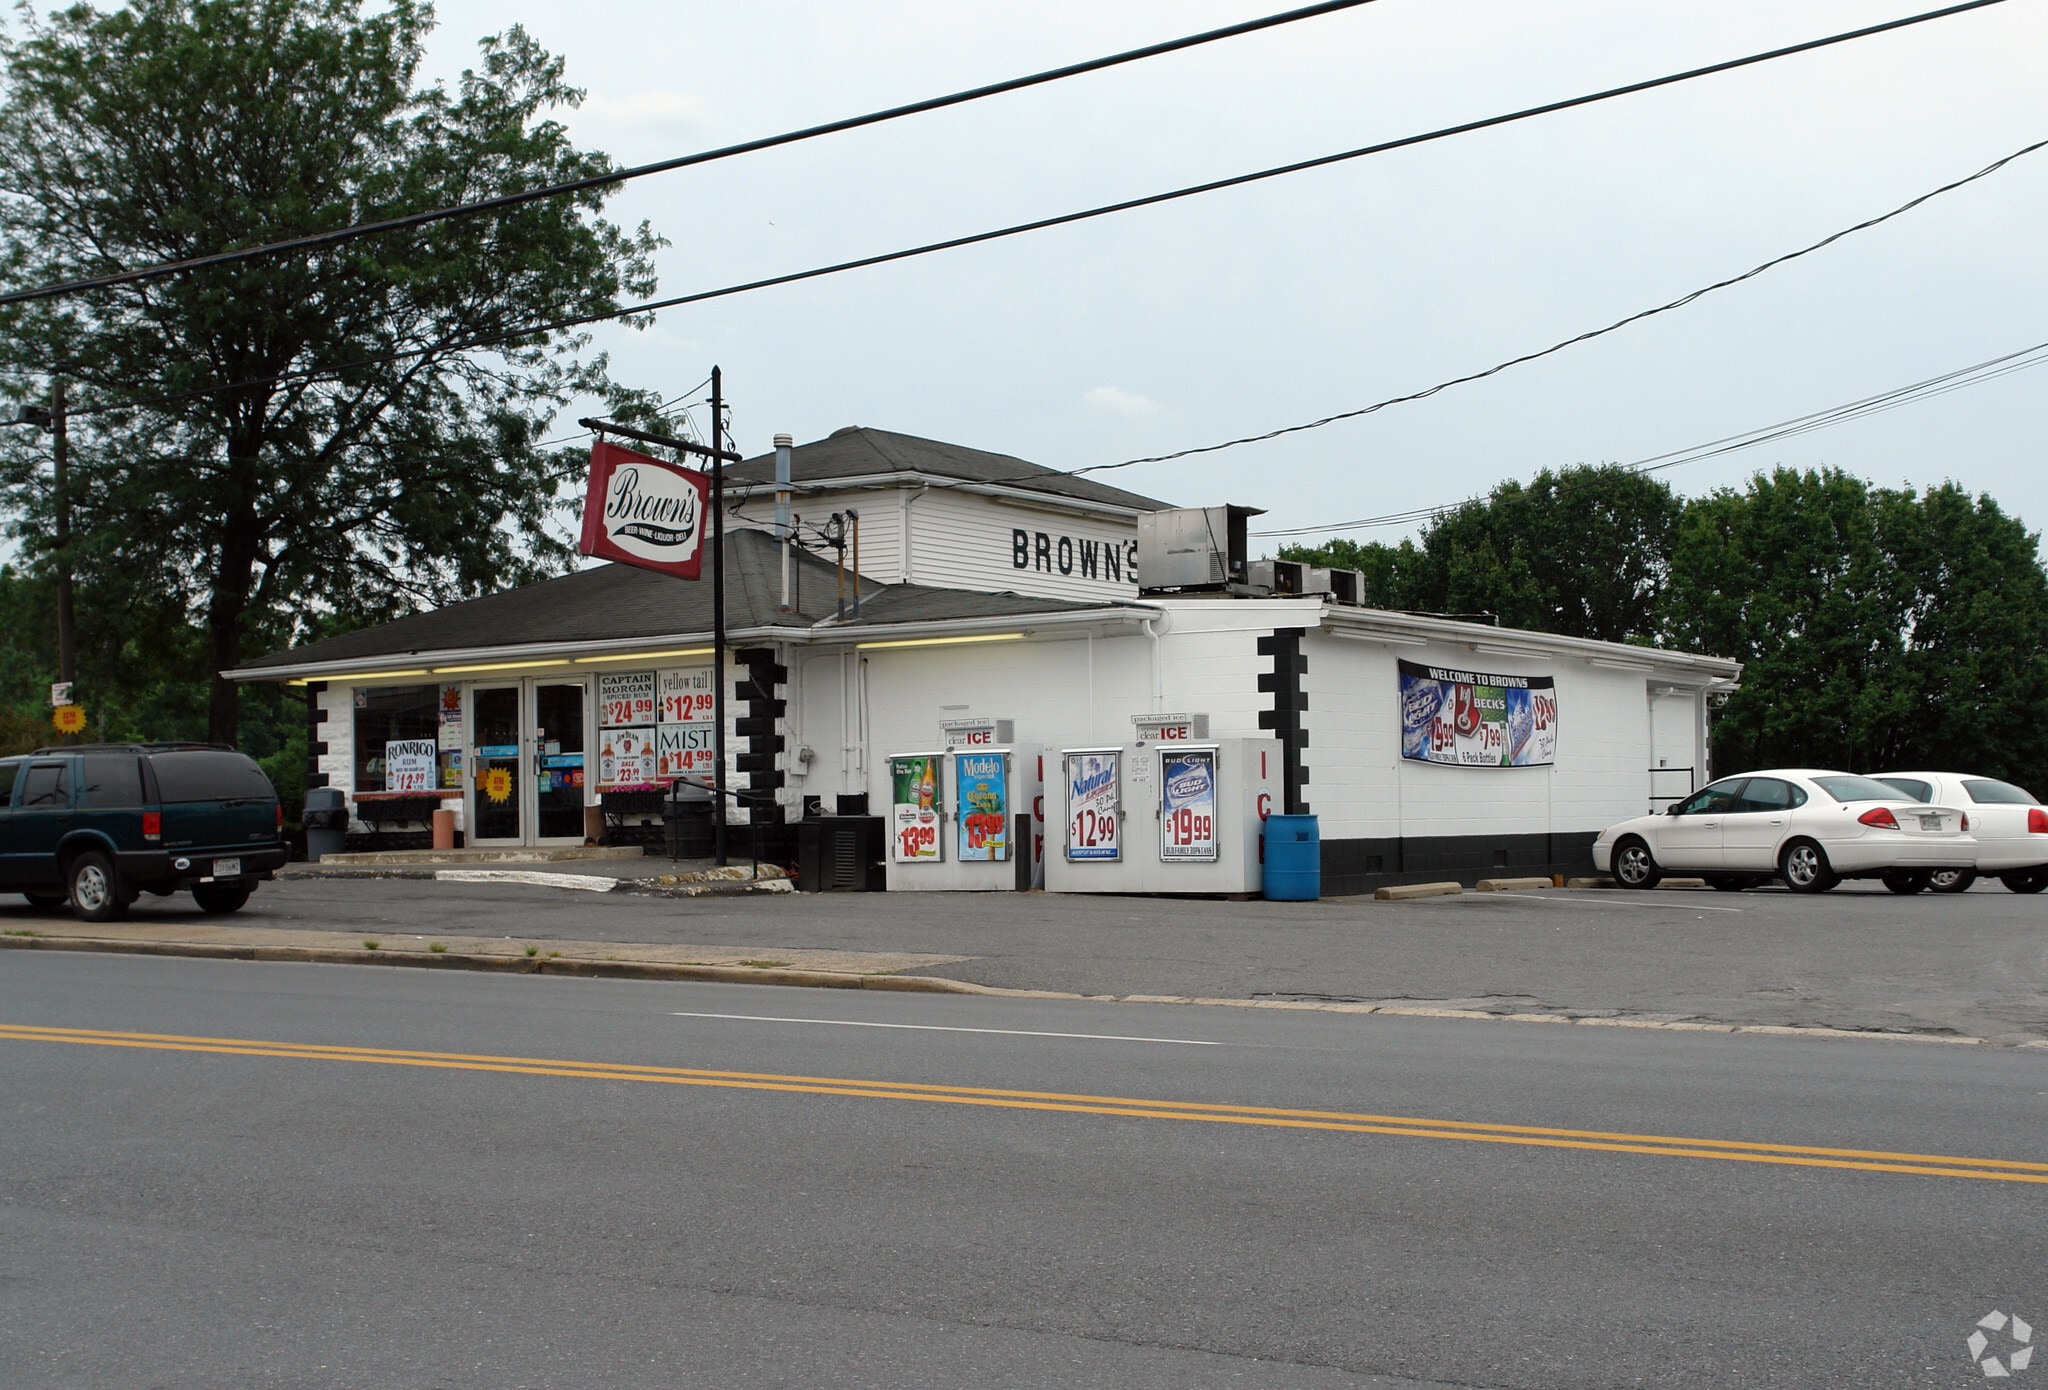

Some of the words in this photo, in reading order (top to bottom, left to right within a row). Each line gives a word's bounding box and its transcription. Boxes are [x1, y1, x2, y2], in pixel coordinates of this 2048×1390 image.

[607, 467, 695, 523] Brown's
[1012, 528, 1139, 584] BROWN'S
[602, 675, 652, 685] CAPTAIN
[1429, 668, 1476, 684] WELCOME
[1476, 674, 1489, 685] TO
[1490, 677, 1528, 688] BROWNS
[602, 684, 652, 694] MORGAN
[608, 699, 653, 723] $24.99
[666, 694, 713, 721] $12.99
[942, 720, 975, 728] packaged
[1134, 715, 1171, 723] packaged
[660, 729, 712, 750] MIST
[966, 731, 991, 745] ICE
[1140, 731, 1159, 740] clear
[1160, 726, 1188, 741] ICE
[388, 742, 434, 761] RONRICO
[669, 750, 713, 770] $14.99
[1467, 752, 1479, 763] Pack
[1479, 752, 1497, 764] Bottles
[402, 758, 417, 766] RUM
[963, 757, 1000, 777] Modelo
[396, 773, 425, 790] $12.99
[1070, 762, 1114, 801] Natural
[1174, 783, 1206, 796] LIGHT
[1179, 779, 1203, 788] BUD
[967, 790, 997, 803] Corona
[1071, 809, 1115, 847] $1299
[1166, 808, 1211, 846] $1999
